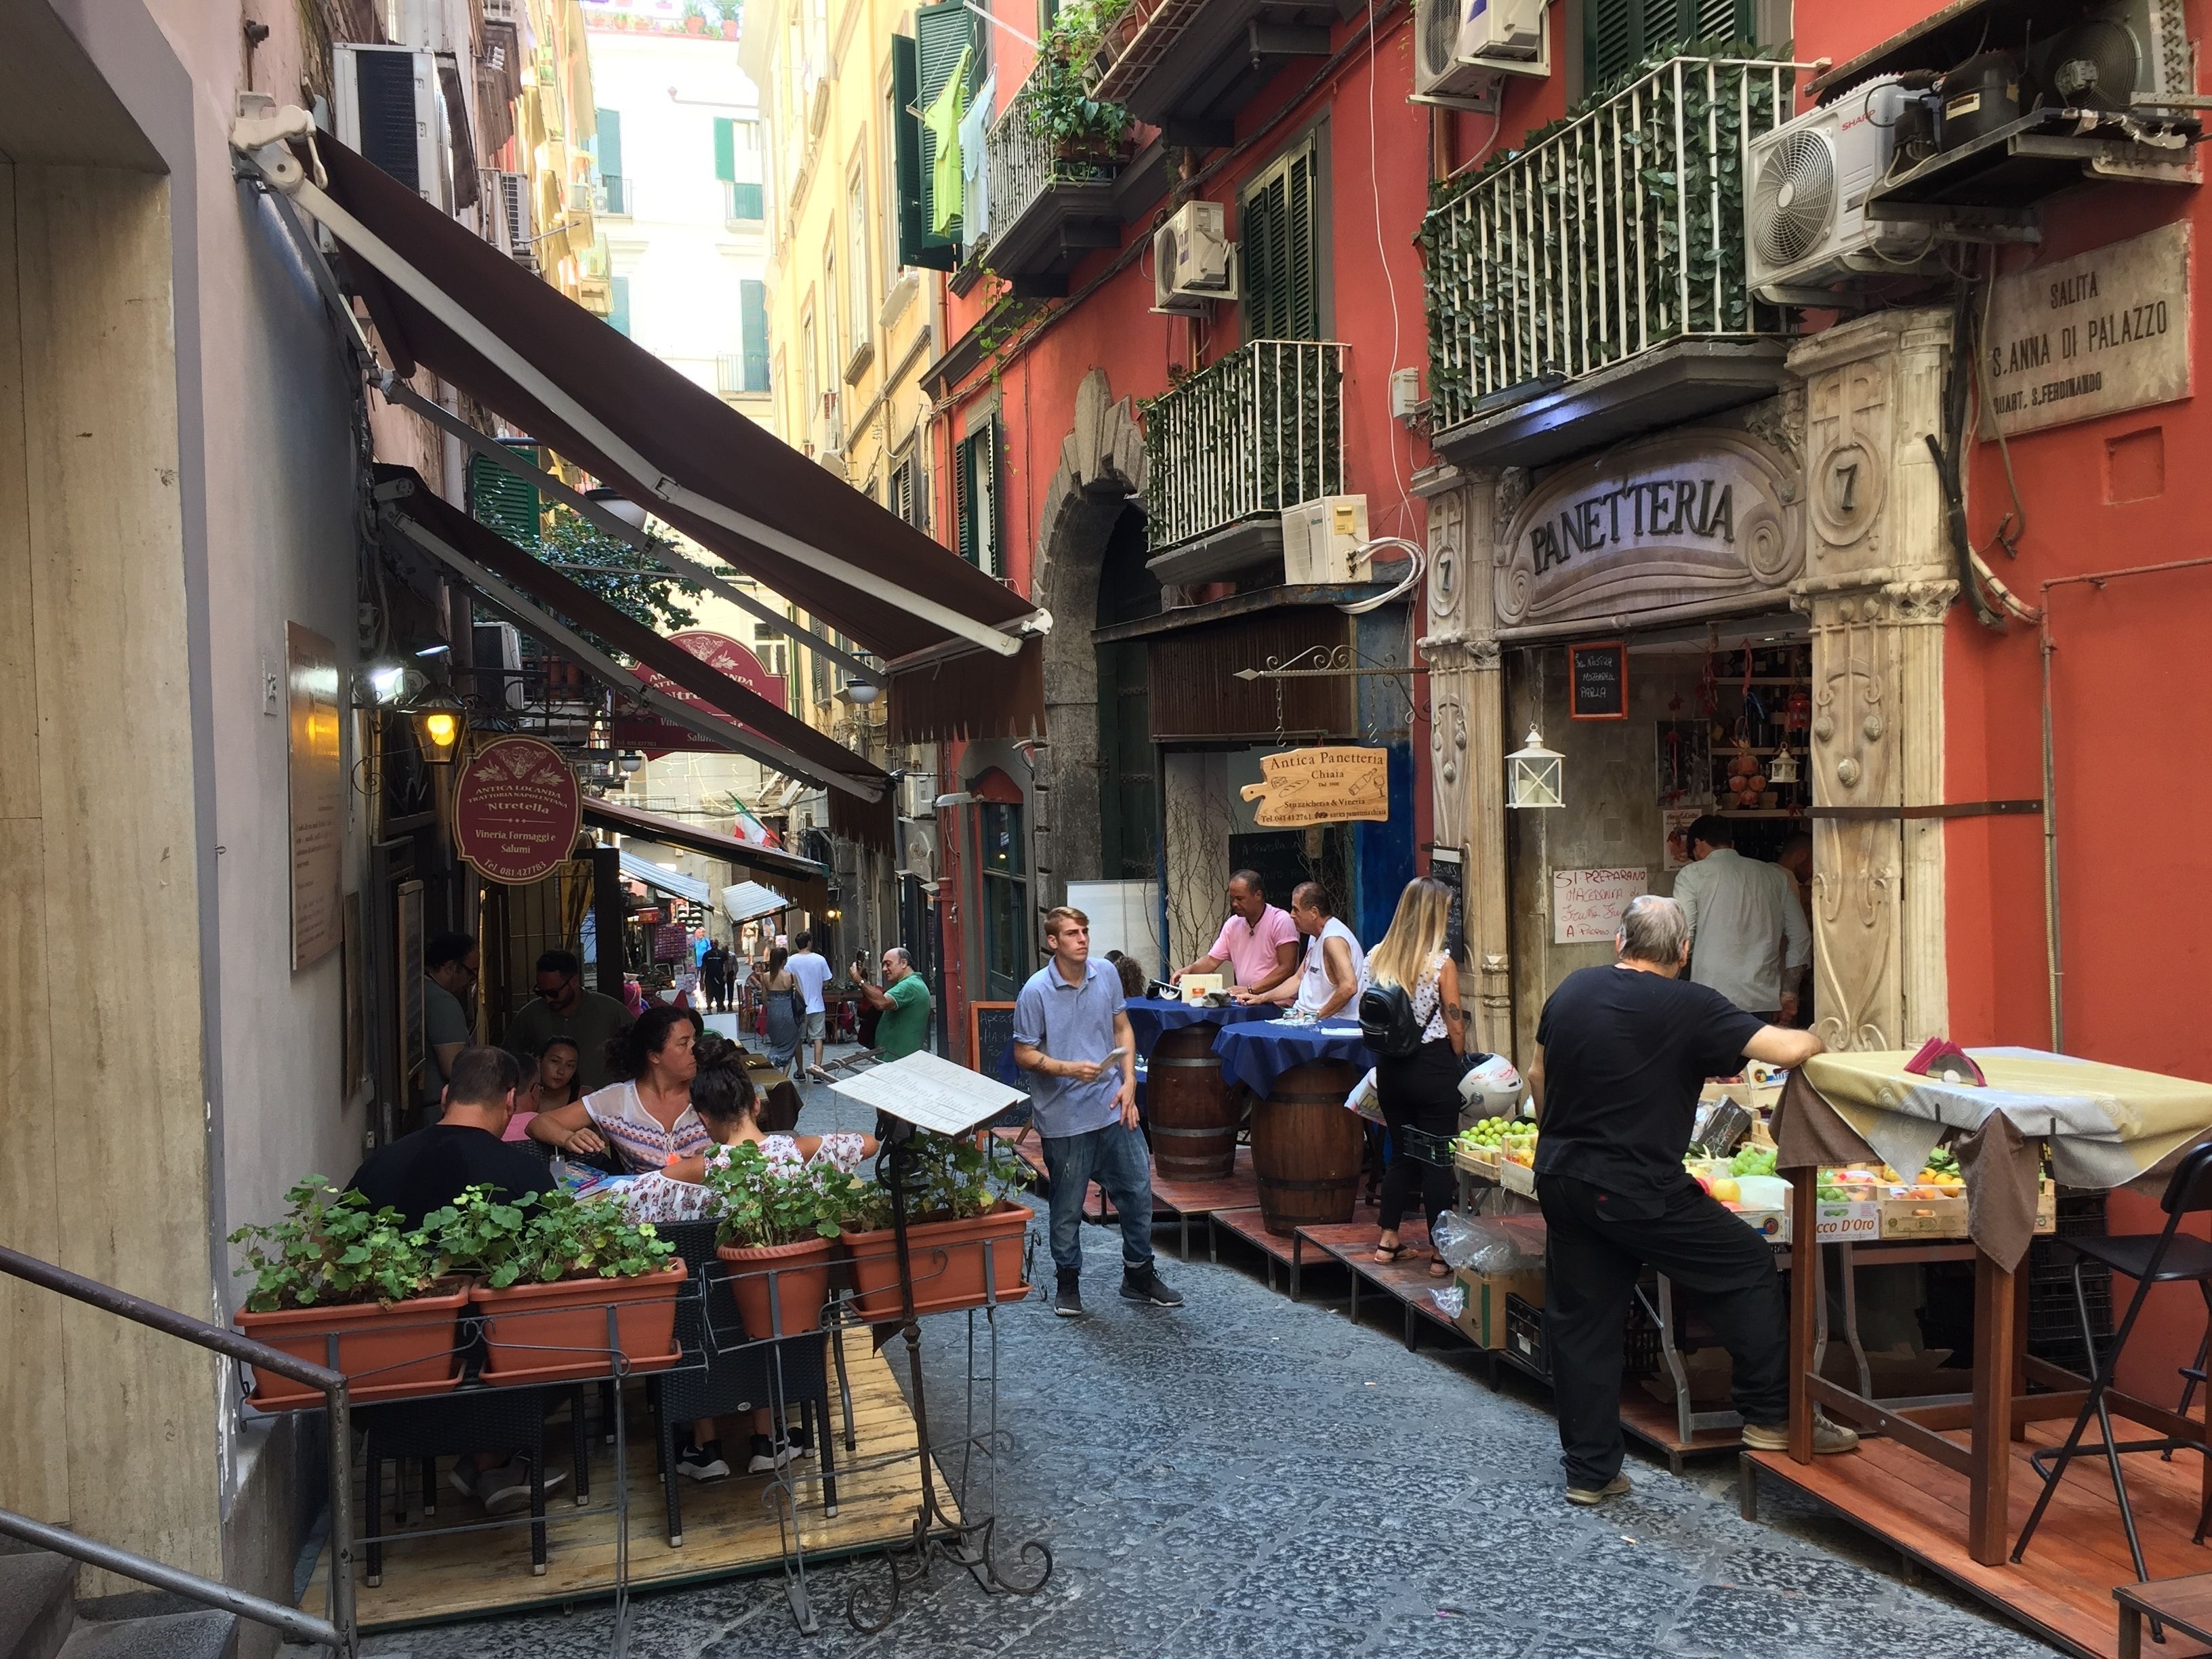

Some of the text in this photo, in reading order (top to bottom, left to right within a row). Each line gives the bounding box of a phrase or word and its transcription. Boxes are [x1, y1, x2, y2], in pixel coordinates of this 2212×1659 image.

[1841, 109, 1876, 131] SHARP
[2050, 272, 2098, 309] SALITA
[1992, 300, 2167, 377] S.ANNA DI PALAZZO
[2031, 371, 2102, 407] S.FERDINANDO
[1835, 463, 1856, 511] 7
[1529, 478, 1735, 576] PANETTERIA
[1437, 559, 1452, 592] 7
[1270, 752, 1384, 771] Antica Panetteria
[1311, 769, 1345, 779] Chiaia
[467, 792, 513, 803] TRATTORIA
[475, 785, 562, 799] ANTICA LOCANDA
[509, 830, 550, 843] Formaggi
[501, 844, 531, 854] Salumi
[1554, 869, 1645, 888] SI PREPARANO
[1566, 888, 1623, 902] MACEDONIA
[1841, 1218, 1875, 1232] D'Oro
